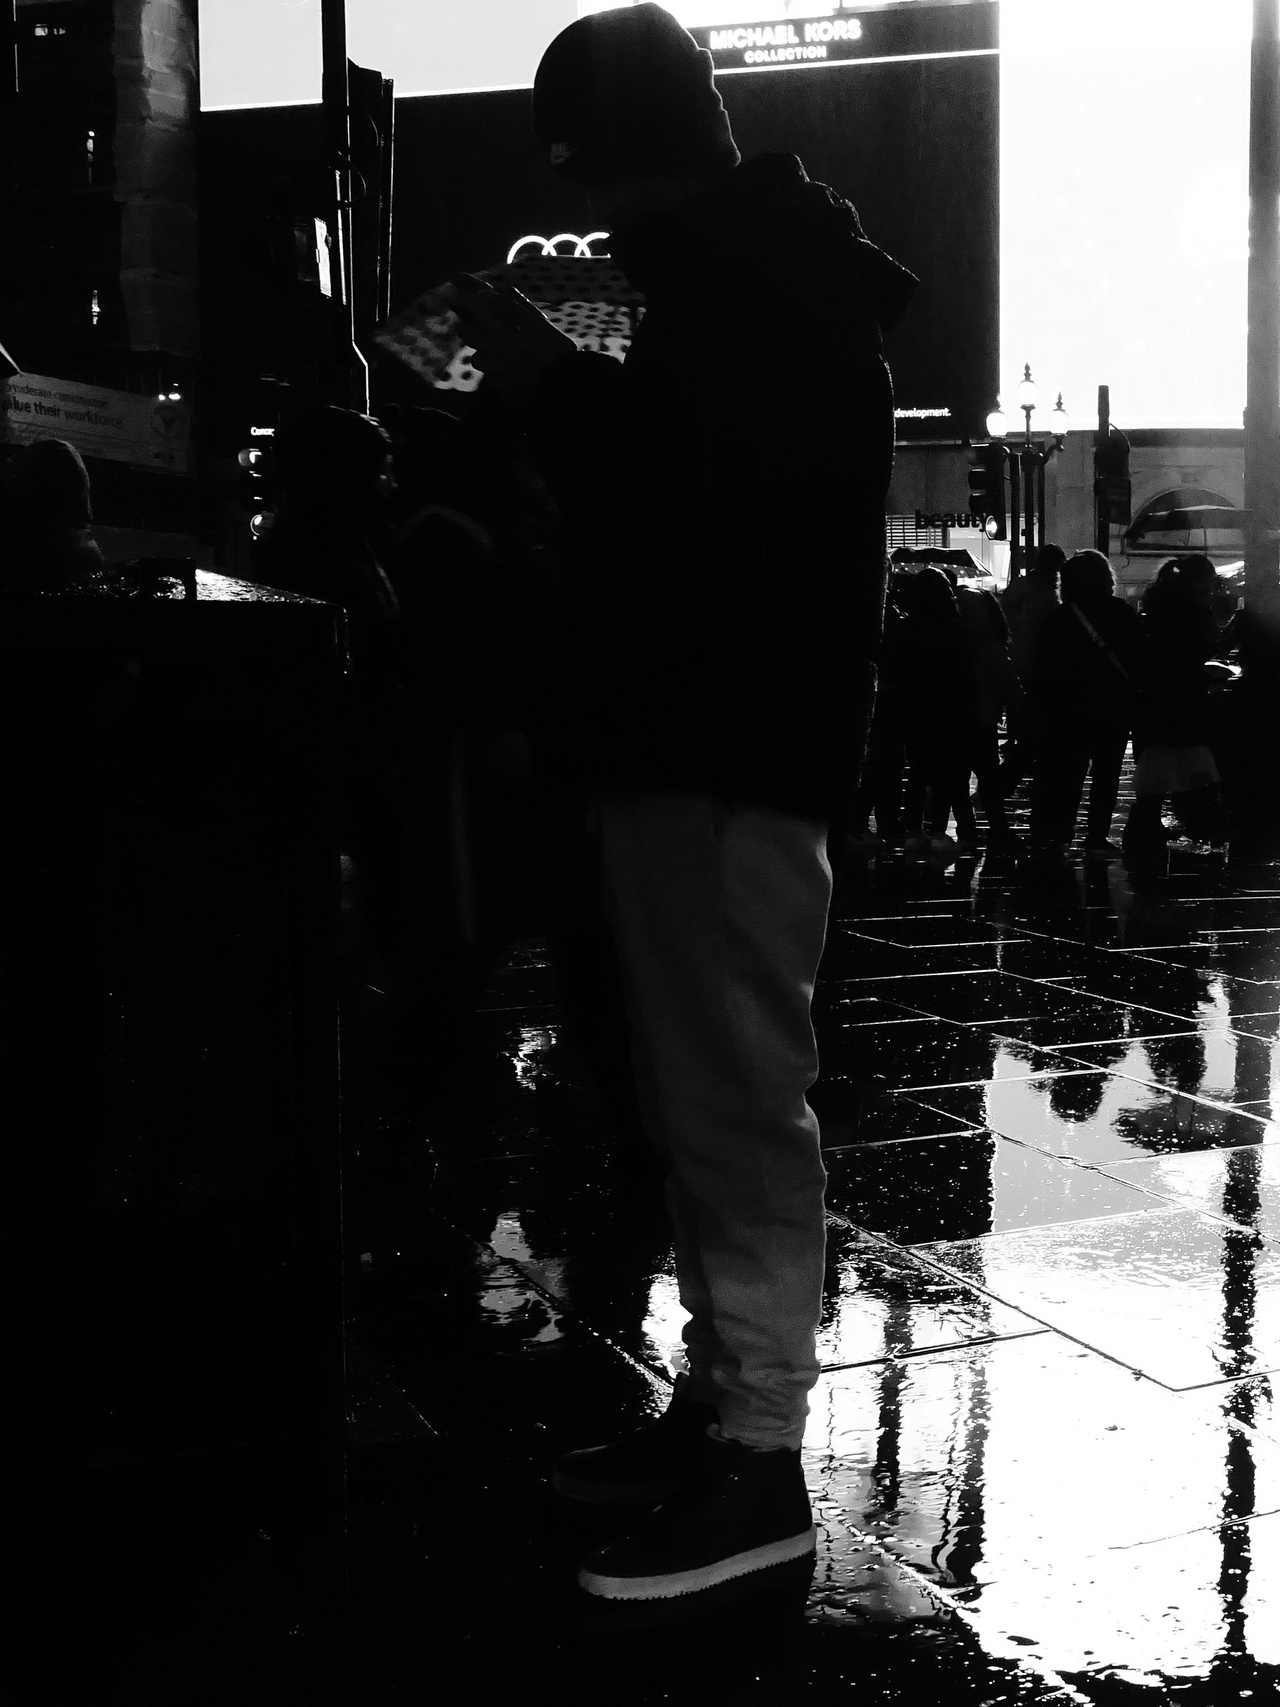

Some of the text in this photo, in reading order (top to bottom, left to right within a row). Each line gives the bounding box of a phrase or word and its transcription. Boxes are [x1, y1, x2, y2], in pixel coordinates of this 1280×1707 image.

[710, 19, 862, 49] MICHAEL KORS
[744, 45, 827, 63] COLLECTION
[34, 401, 61, 417] their
[64, 409, 123, 429] workforce
